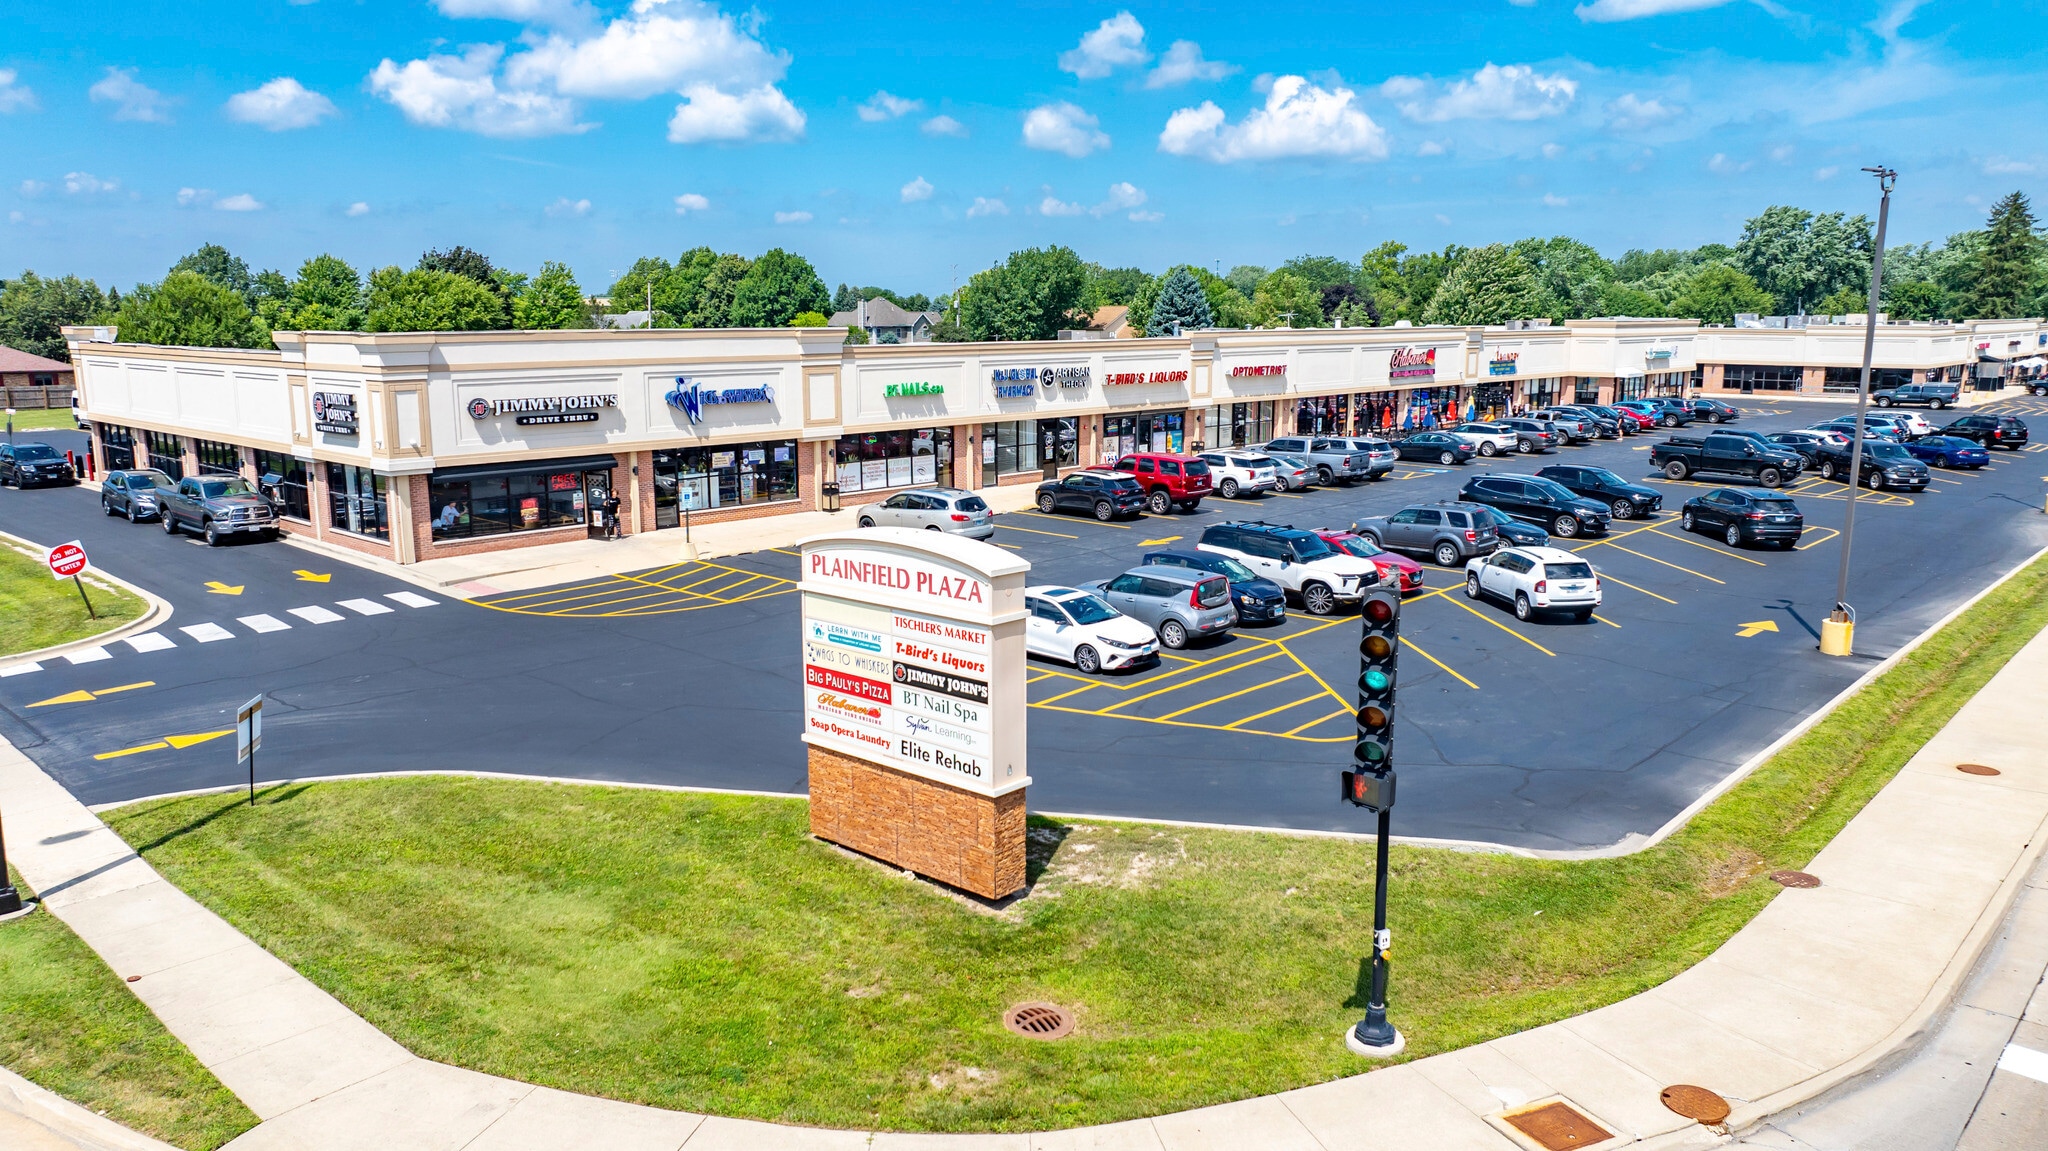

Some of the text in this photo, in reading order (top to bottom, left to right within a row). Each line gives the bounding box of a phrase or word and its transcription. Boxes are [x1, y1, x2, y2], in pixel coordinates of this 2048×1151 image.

[1055, 367, 1091, 378] ARTISAN
[1107, 370, 1188, 385] T-BIRD'S LIQUORS
[1233, 365, 1287, 377] OPTOMETRIST
[900, 382, 930, 396] NAILS
[996, 385, 1035, 398] PHARMACY
[1061, 380, 1087, 388] THEORY
[324, 392, 350, 407] JIMMY
[494, 394, 618, 416] JIMMY JOHN'S
[326, 408, 352, 422] JOHN'S
[528, 416, 560, 424] DRIVE
[552, 473, 575, 484] FREE
[64, 548, 77, 556] NOT
[60, 561, 82, 572] ENTER
[812, 554, 982, 604] PLAINFIELD PLAZA
[828, 625, 882, 642] LEARN WITH ME
[894, 616, 986, 644] TISCHLER'S MARKET
[816, 648, 889, 675] WAGS TO WHISKERS
[896, 642, 938, 662] T-Bird's
[942, 652, 984, 672] Liquors
[808, 668, 889, 700] BIG PAULY'S PIZZA
[906, 669, 988, 698] JIMMY JOHN'S
[904, 690, 978, 722] BT Nail Spa
[811, 718, 891, 750] Soap Opera Laundry
[906, 716, 972, 745] Sylvan Learning
[901, 740, 981, 777] Elite Rehab
